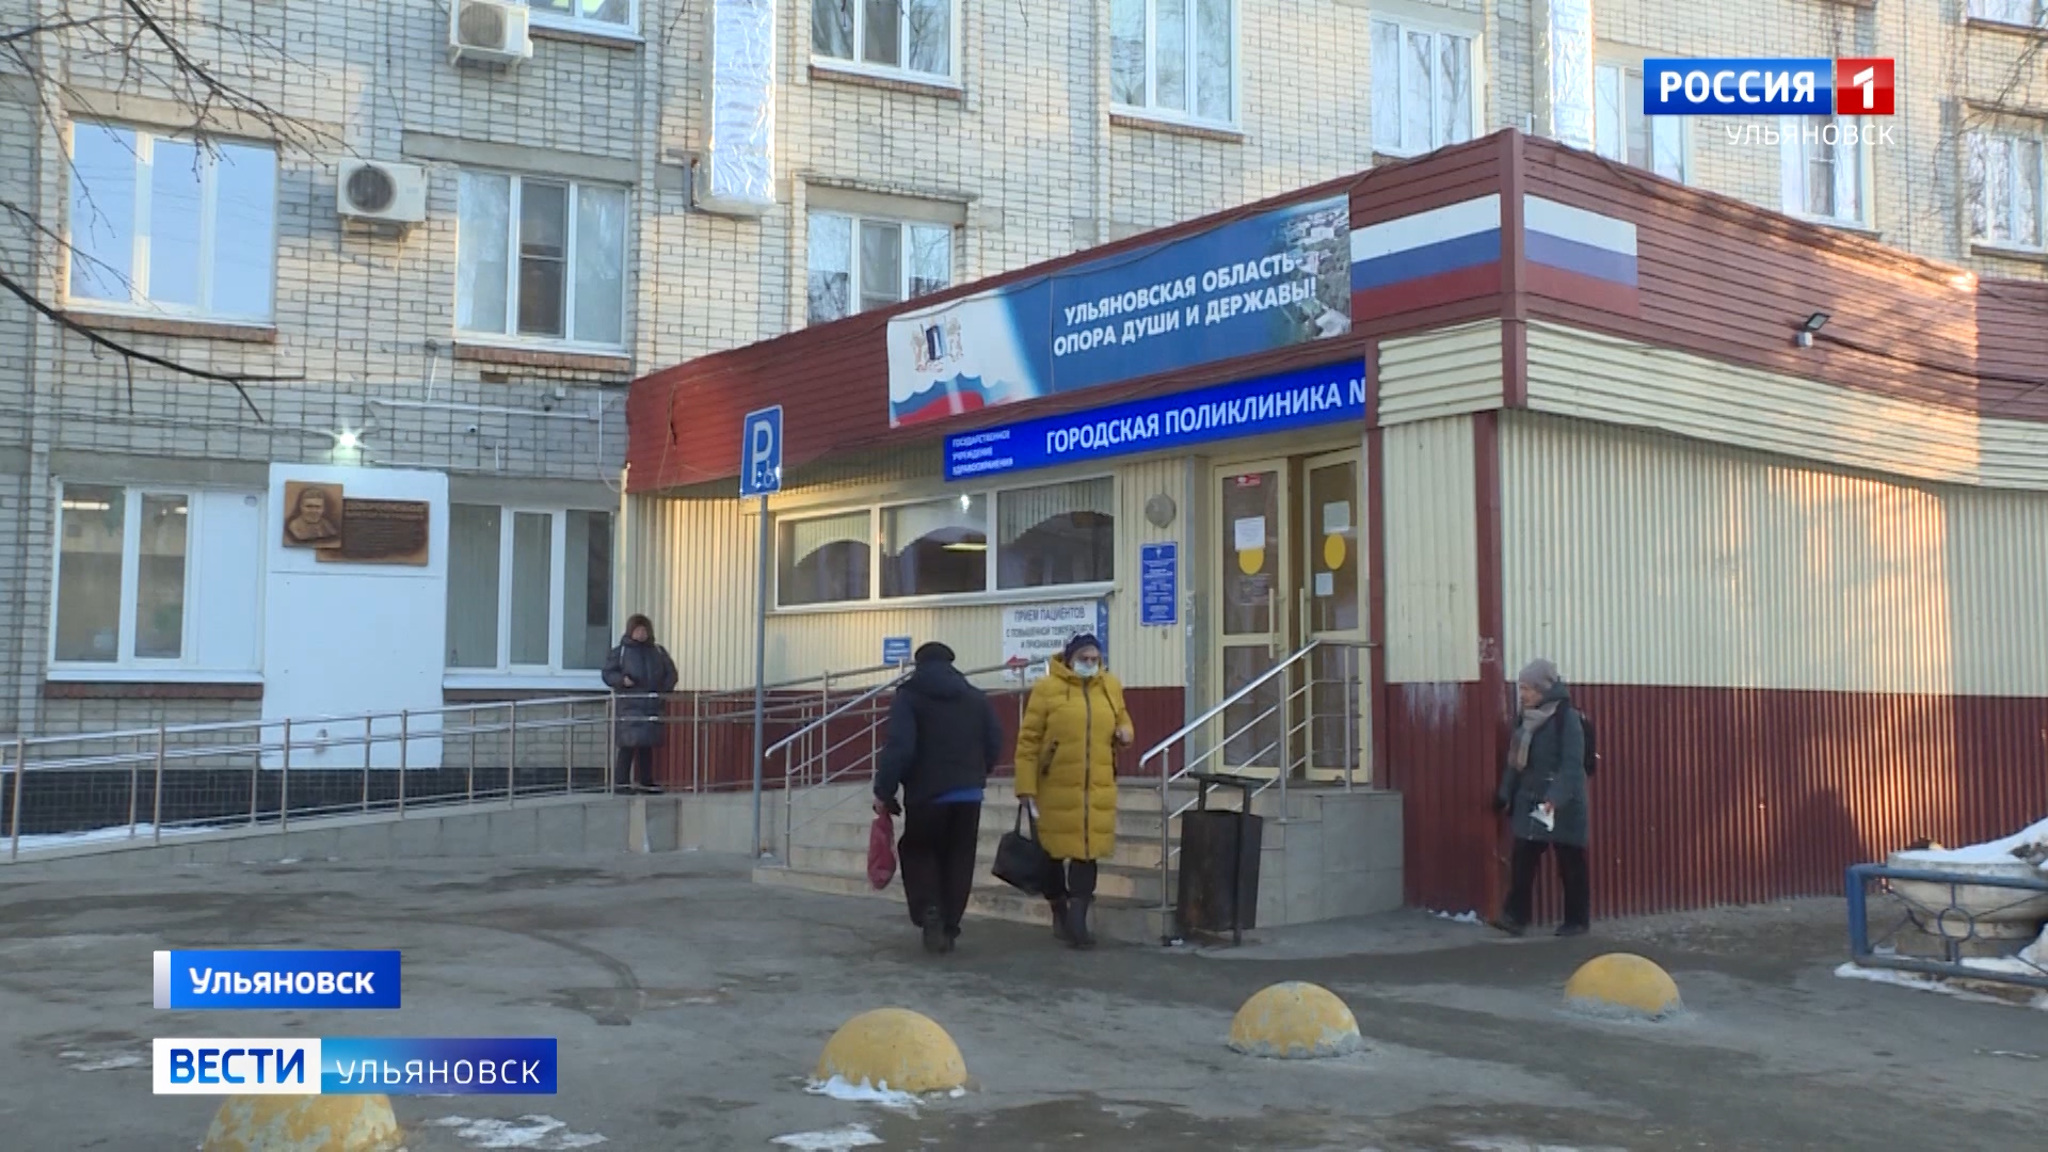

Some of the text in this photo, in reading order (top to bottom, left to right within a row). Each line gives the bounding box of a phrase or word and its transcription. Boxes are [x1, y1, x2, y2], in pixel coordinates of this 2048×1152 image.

[1054, 276, 1317, 357] ОПОРА ДУШИ И ДЕРЖАВЫ!
[1064, 272, 1196, 327] УЛЬЯНОВСКАЯ
[1046, 415, 1159, 455] ГОРОДСКАЯ
[1165, 381, 1342, 435] ПОЛИКЛИНИКА
[751, 420, 773, 487] P
[1040, 606, 1086, 621] ПАЦИЕНТОВ
